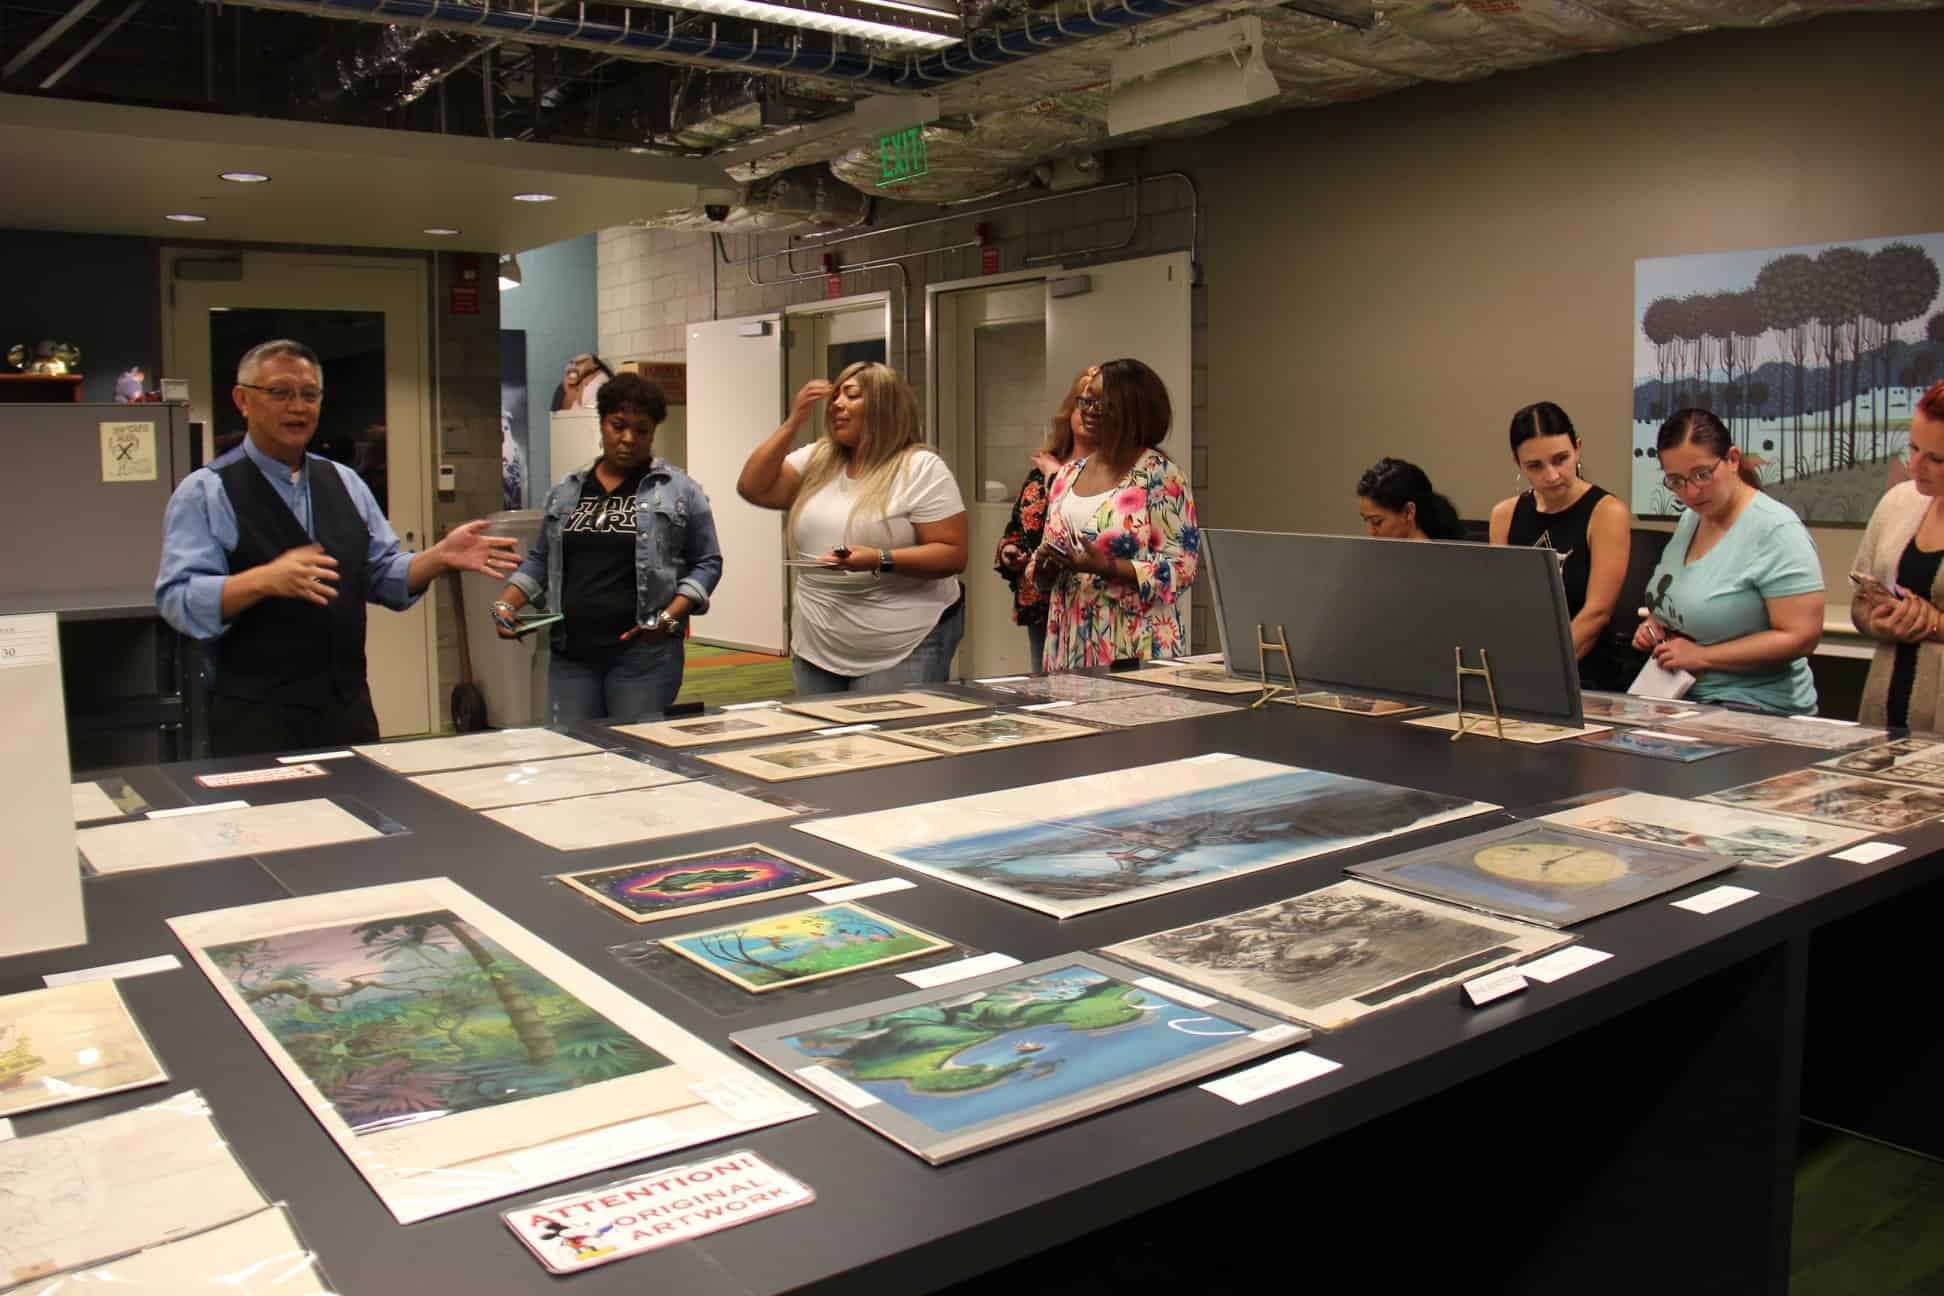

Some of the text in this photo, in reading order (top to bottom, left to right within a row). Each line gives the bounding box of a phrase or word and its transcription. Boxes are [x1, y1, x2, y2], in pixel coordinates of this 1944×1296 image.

[880, 128, 920, 177] EXIT
[575, 495, 640, 513] TAR
[529, 1157, 755, 1228] ATTENTION!
[613, 1179, 769, 1226] ORIGINAL
[632, 1186, 785, 1241] ARTWORK
